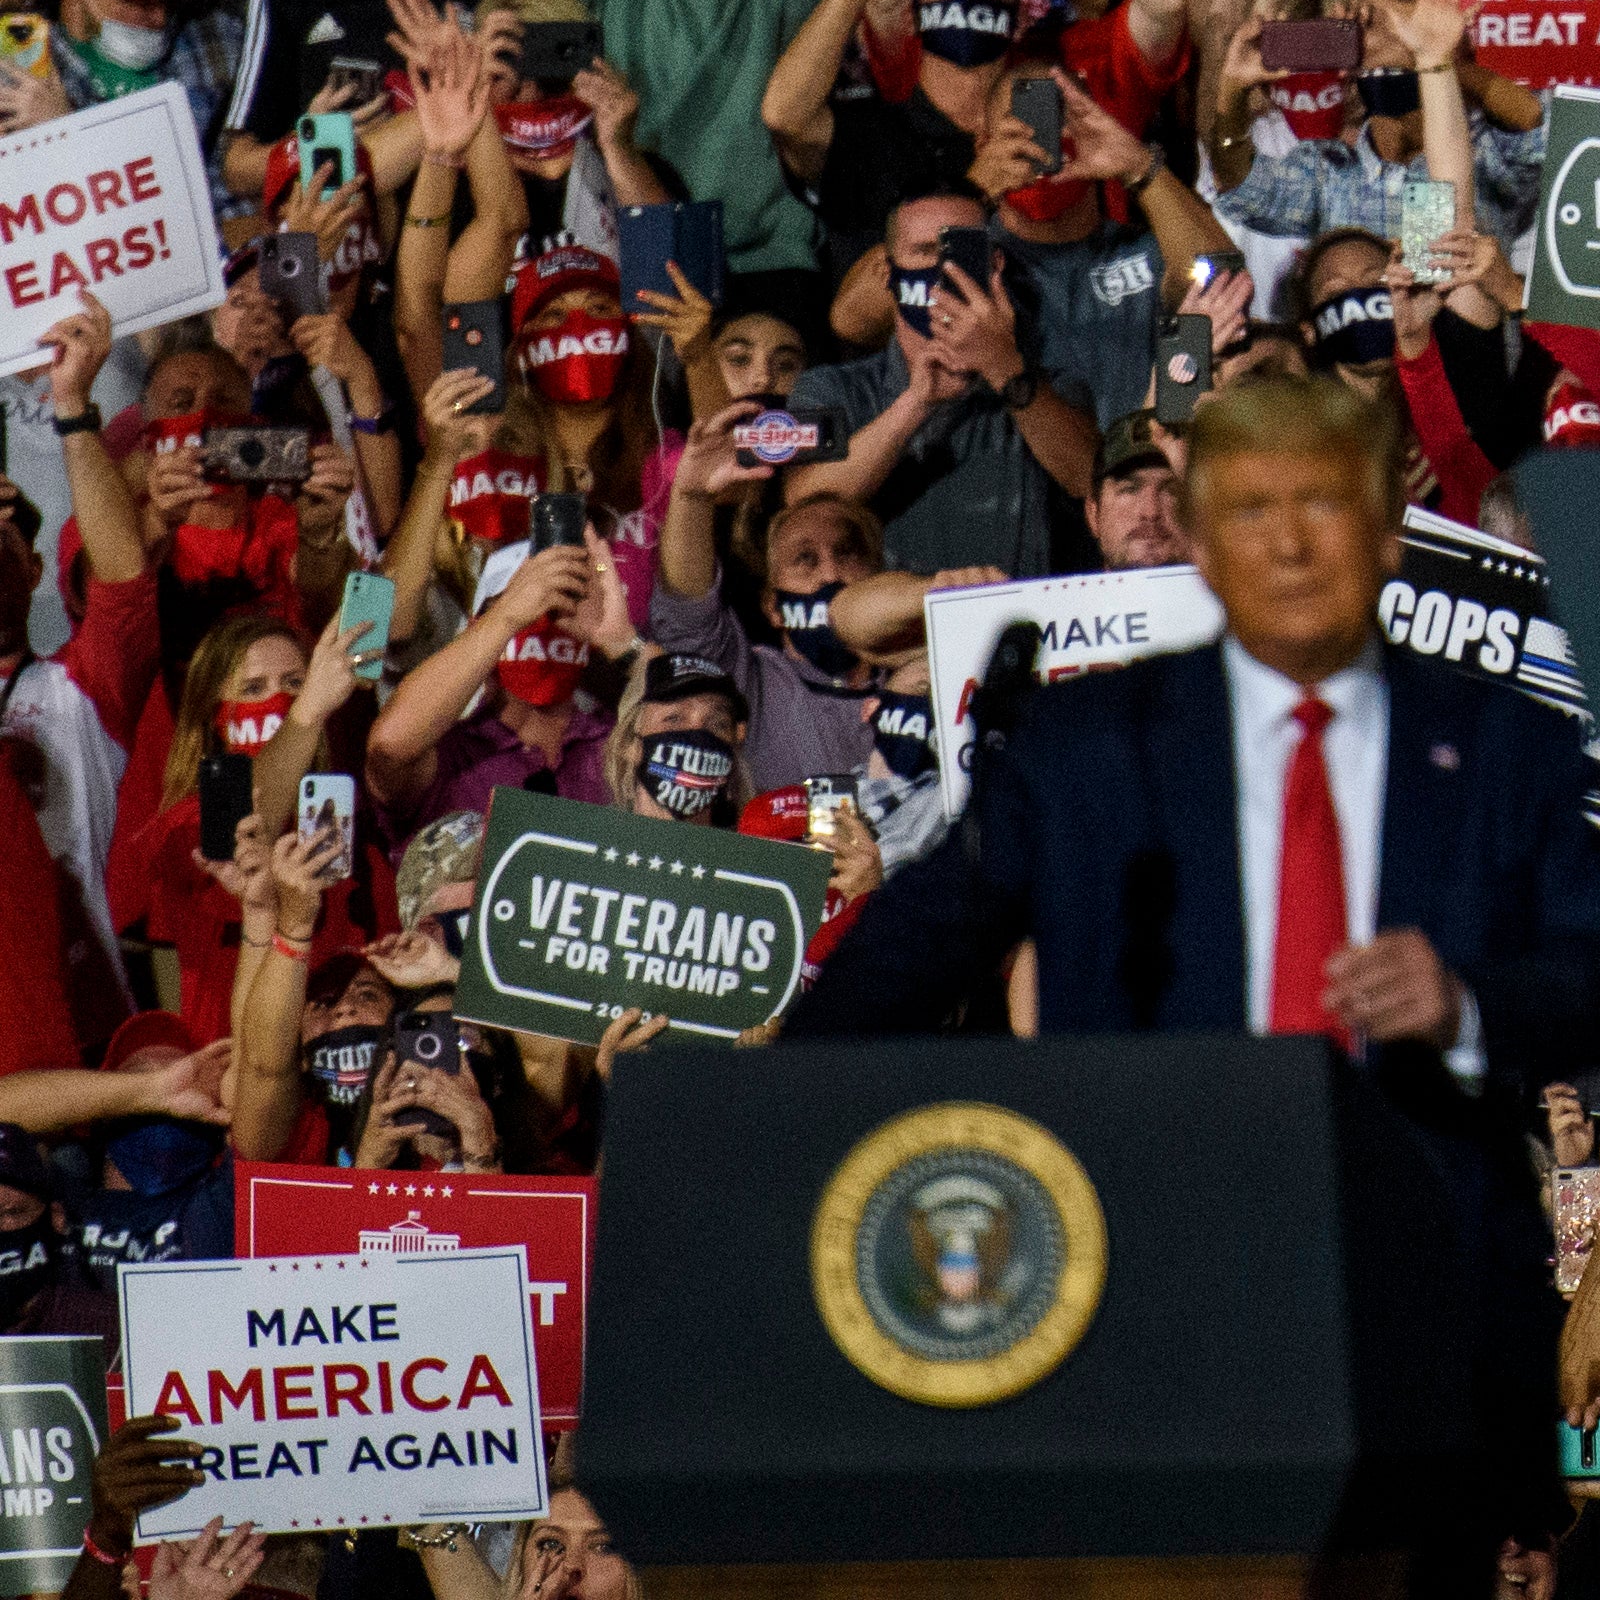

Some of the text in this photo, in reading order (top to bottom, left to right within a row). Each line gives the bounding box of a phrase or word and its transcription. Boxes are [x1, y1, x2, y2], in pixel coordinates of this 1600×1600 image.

[1039, 611, 1149, 651] MAKE
[1379, 579, 1521, 674] COPS
[530, 872, 777, 959] VETERANS
[546, 940, 740, 997] FOR TRUMP
[248, 1303, 400, 1348] MAKE
[152, 1354, 514, 1428] AMERICA
[348, 1428, 519, 1473] AGAIN
